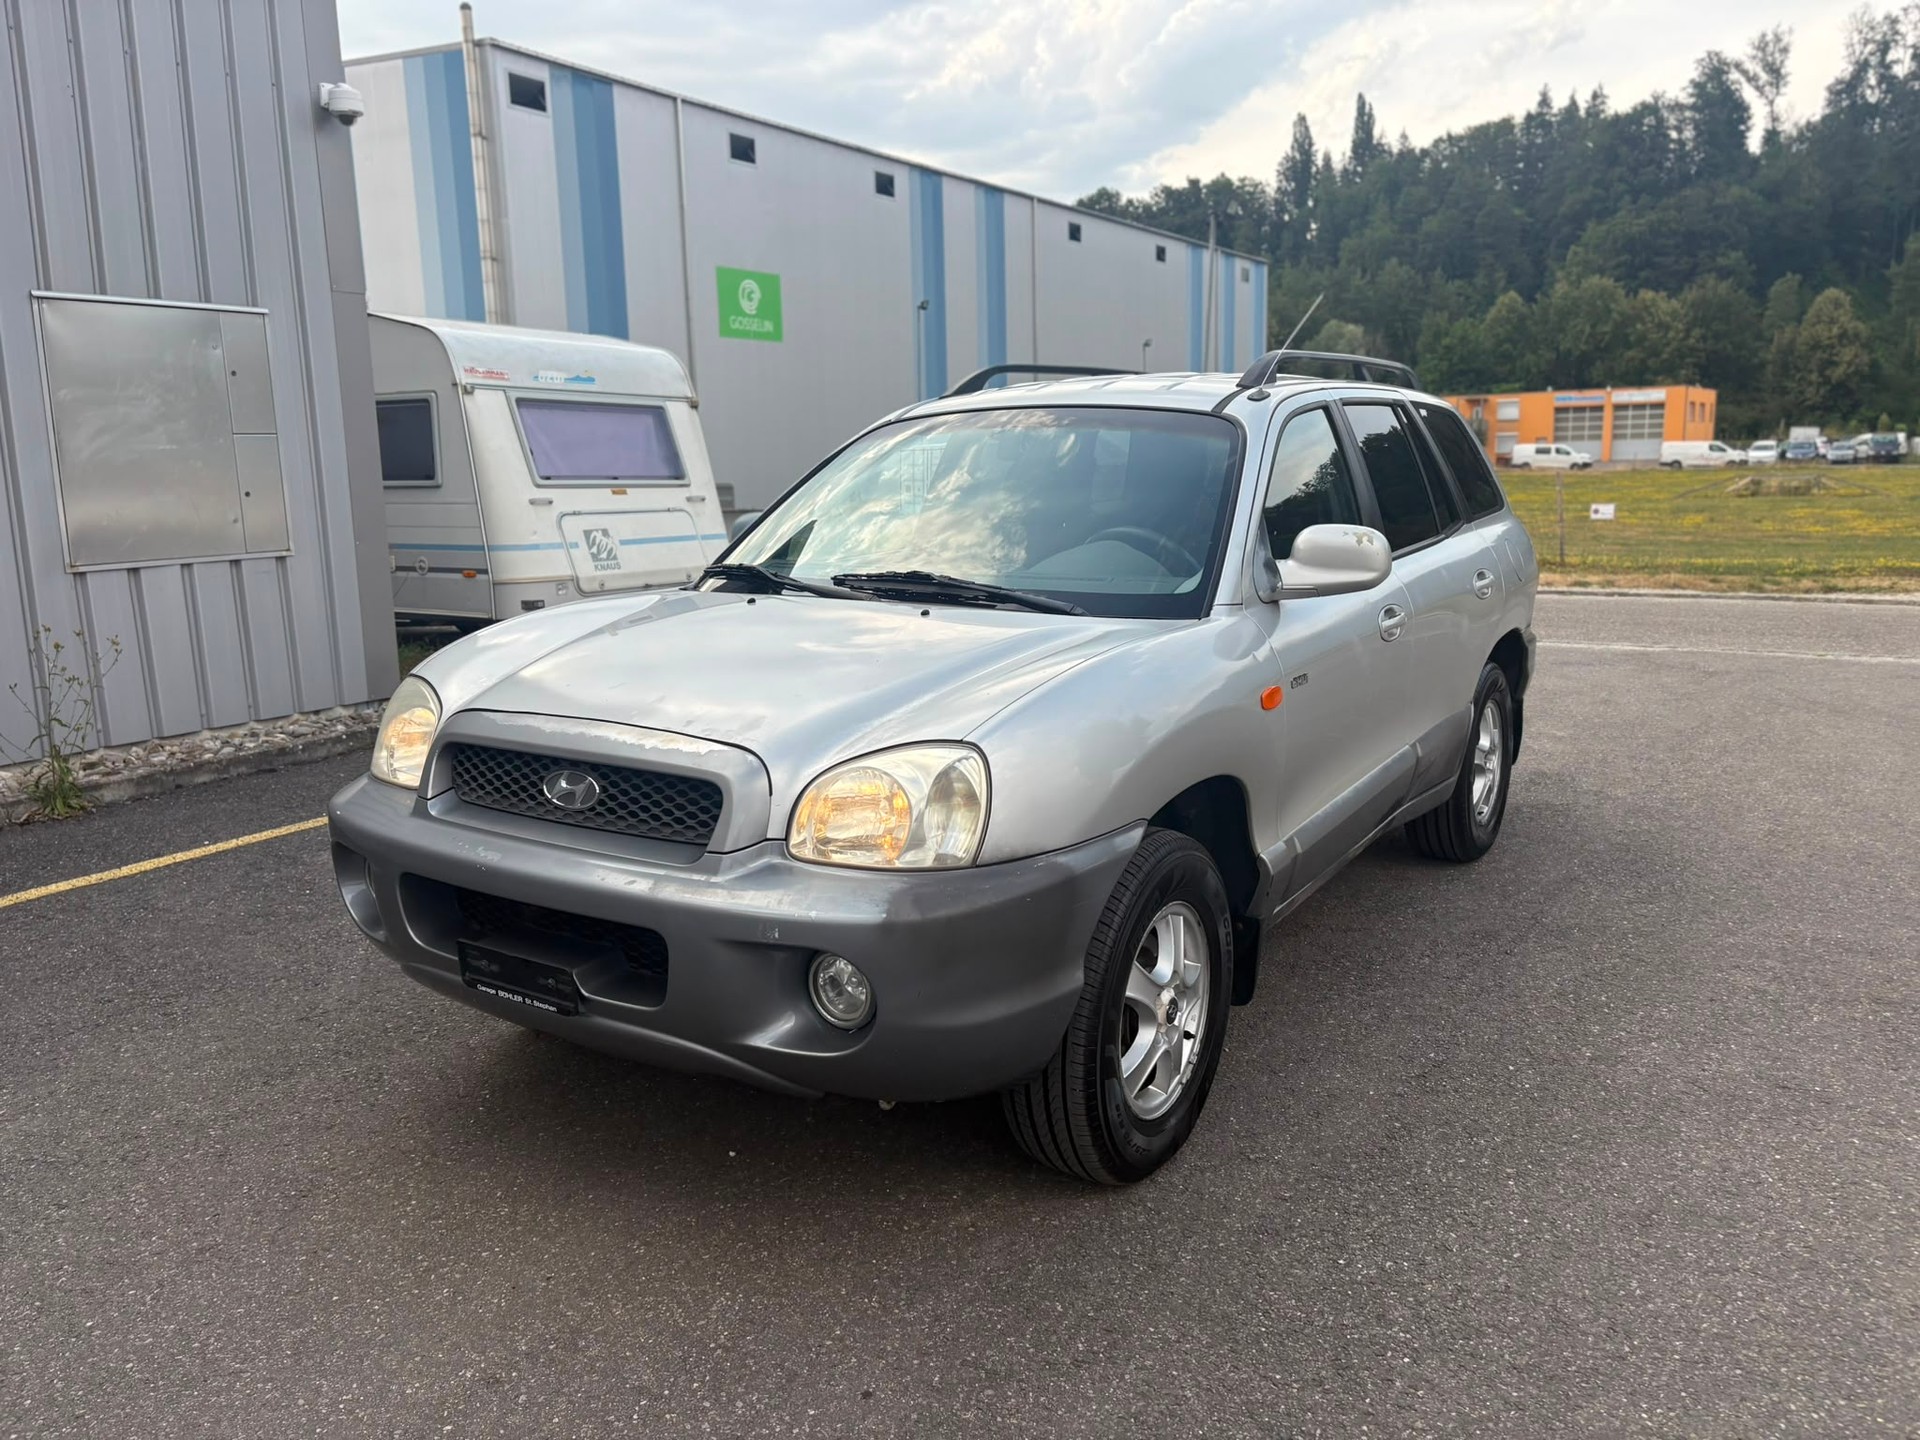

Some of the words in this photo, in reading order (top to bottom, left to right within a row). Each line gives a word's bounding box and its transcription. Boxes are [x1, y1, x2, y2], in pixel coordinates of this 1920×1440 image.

[729, 315, 774, 332] GOSSELIN
[593, 561, 622, 573] KNAUS
[476, 983, 497, 995] Garage
[533, 999, 558, 1012] Stephan
